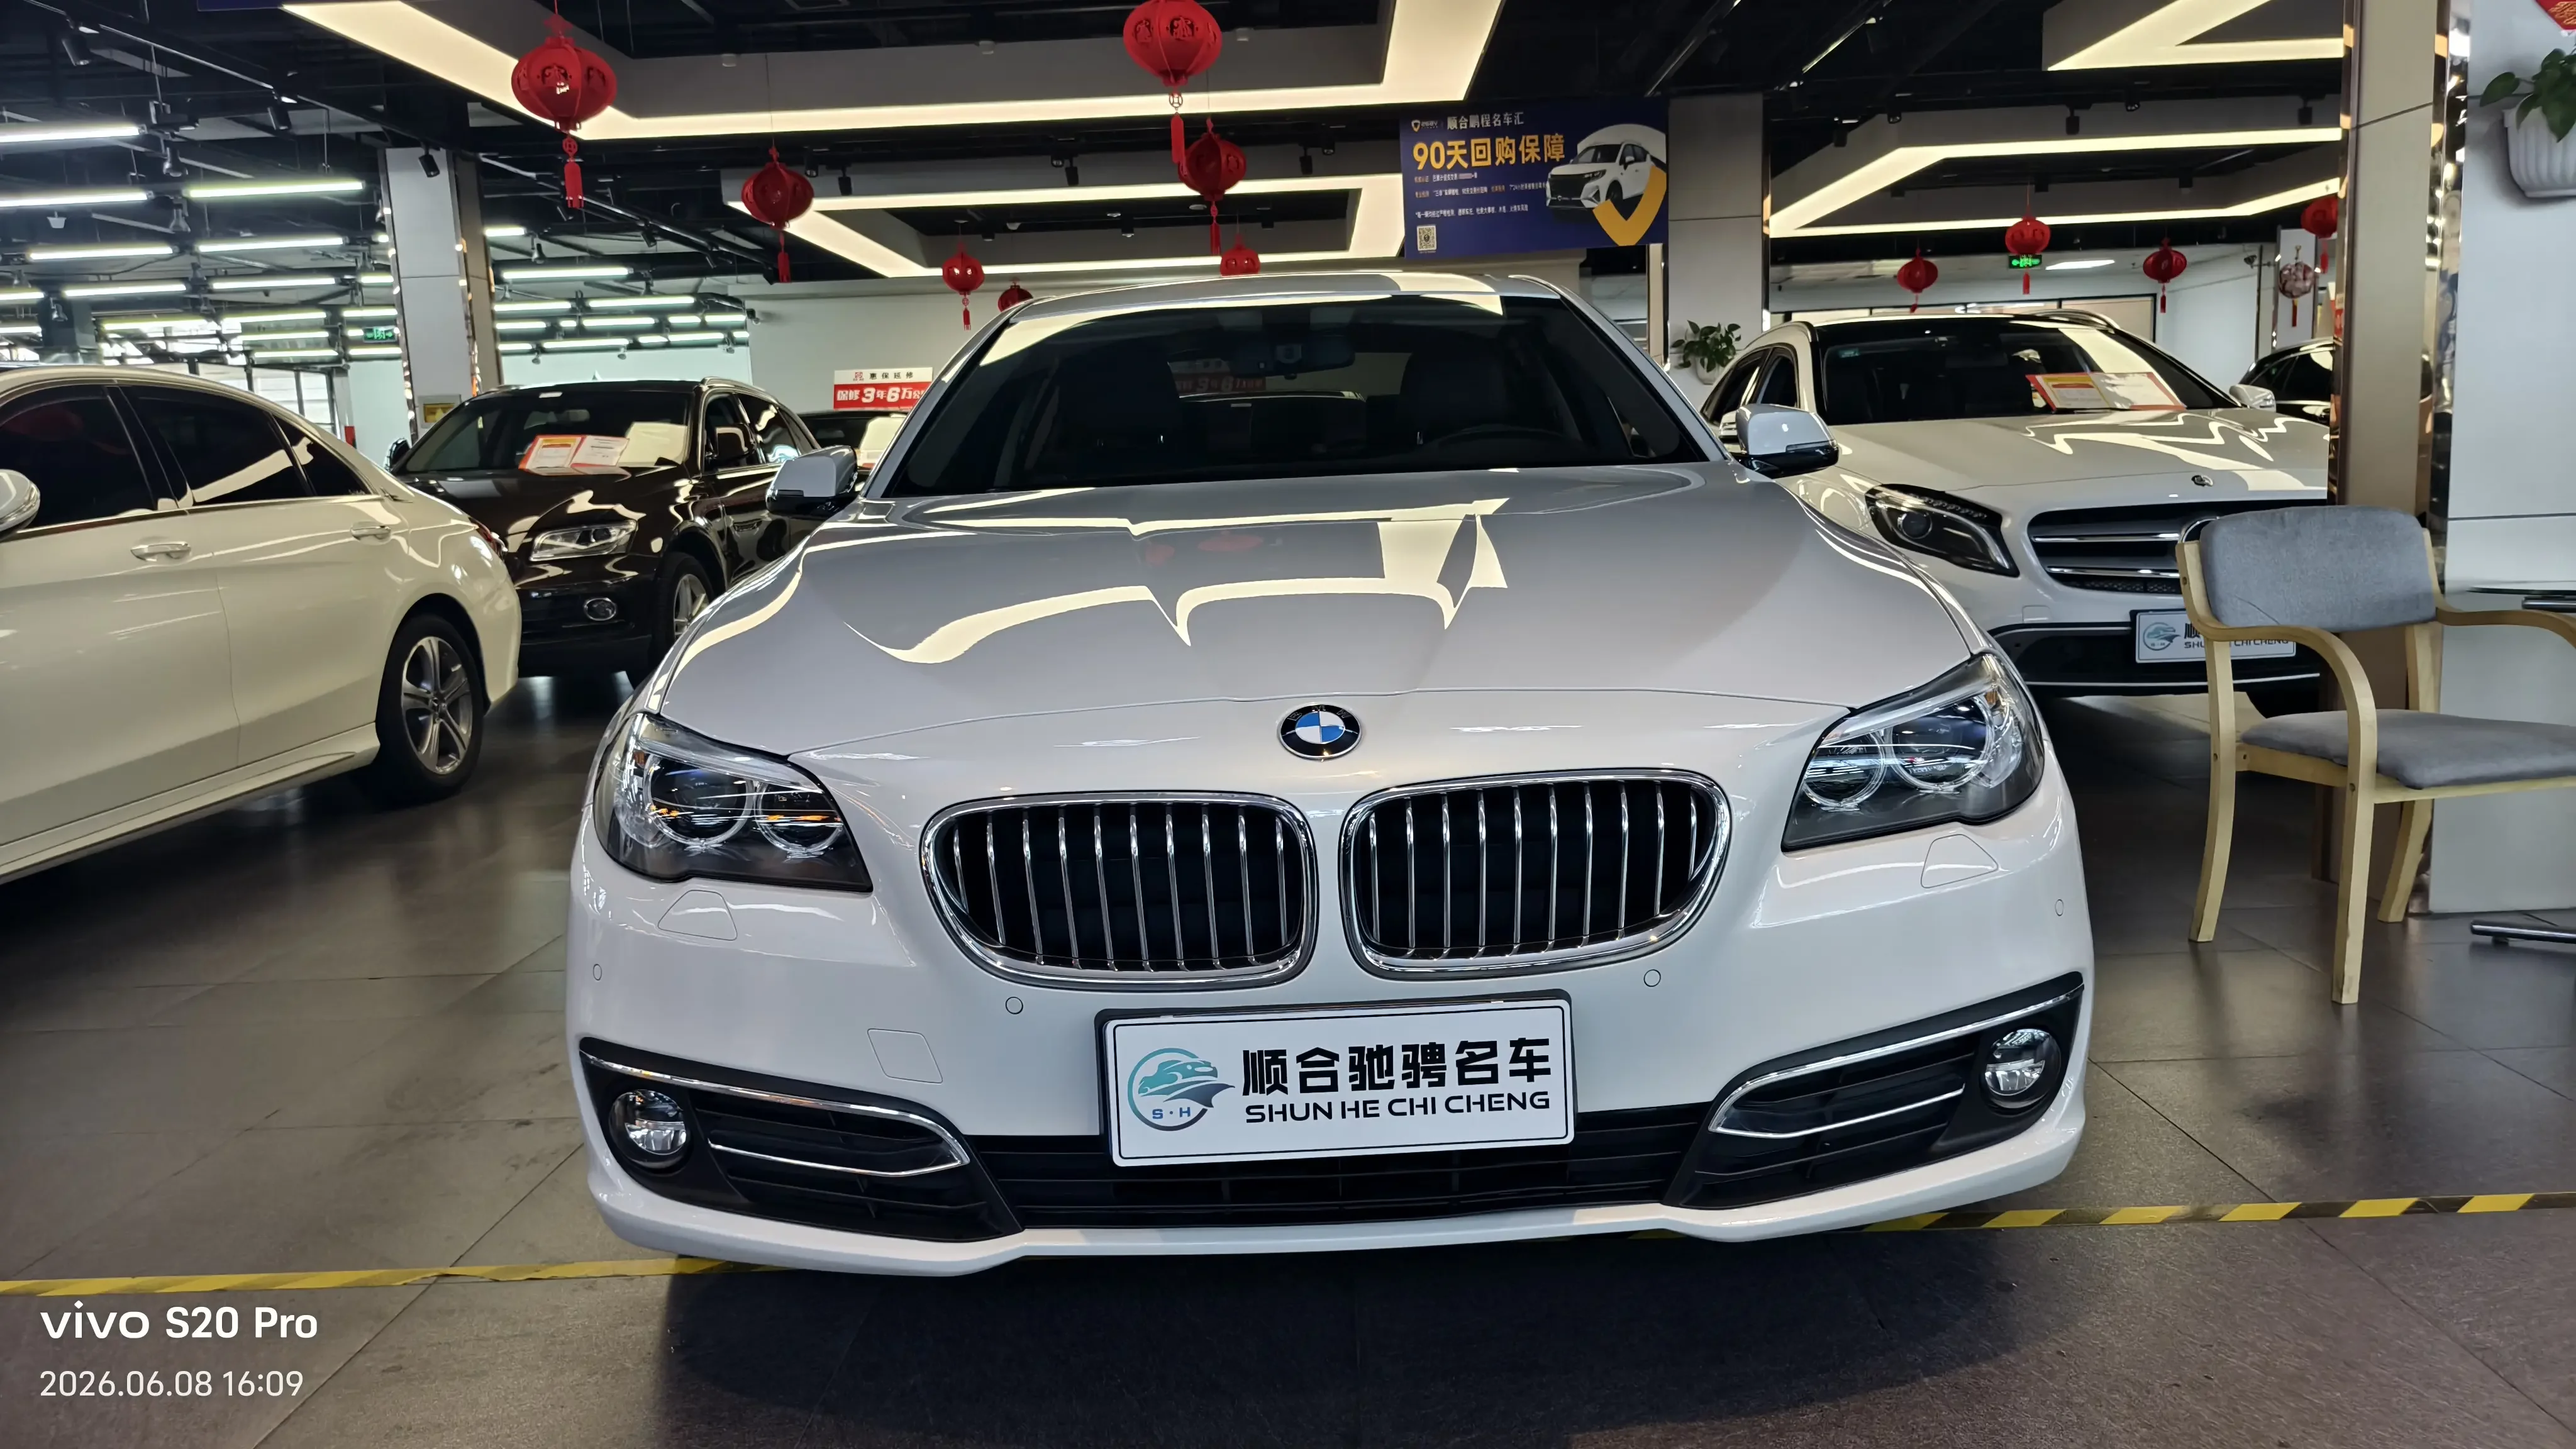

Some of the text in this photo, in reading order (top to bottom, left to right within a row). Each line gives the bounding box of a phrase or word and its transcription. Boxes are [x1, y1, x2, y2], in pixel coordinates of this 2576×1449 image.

[1447, 112, 1524, 130] 顺合鹏程名车汇
[1413, 133, 1565, 170] 90天回购保障
[870, 372, 914, 380] 惠保延修
[836, 387, 924, 403] 保修3年6万公
[1287, 704, 1352, 721] BMW
[1242, 1038, 1552, 1096] 顺合驰骋名车
[1245, 1091, 1550, 1123] SHUN HE CHI CHENG
